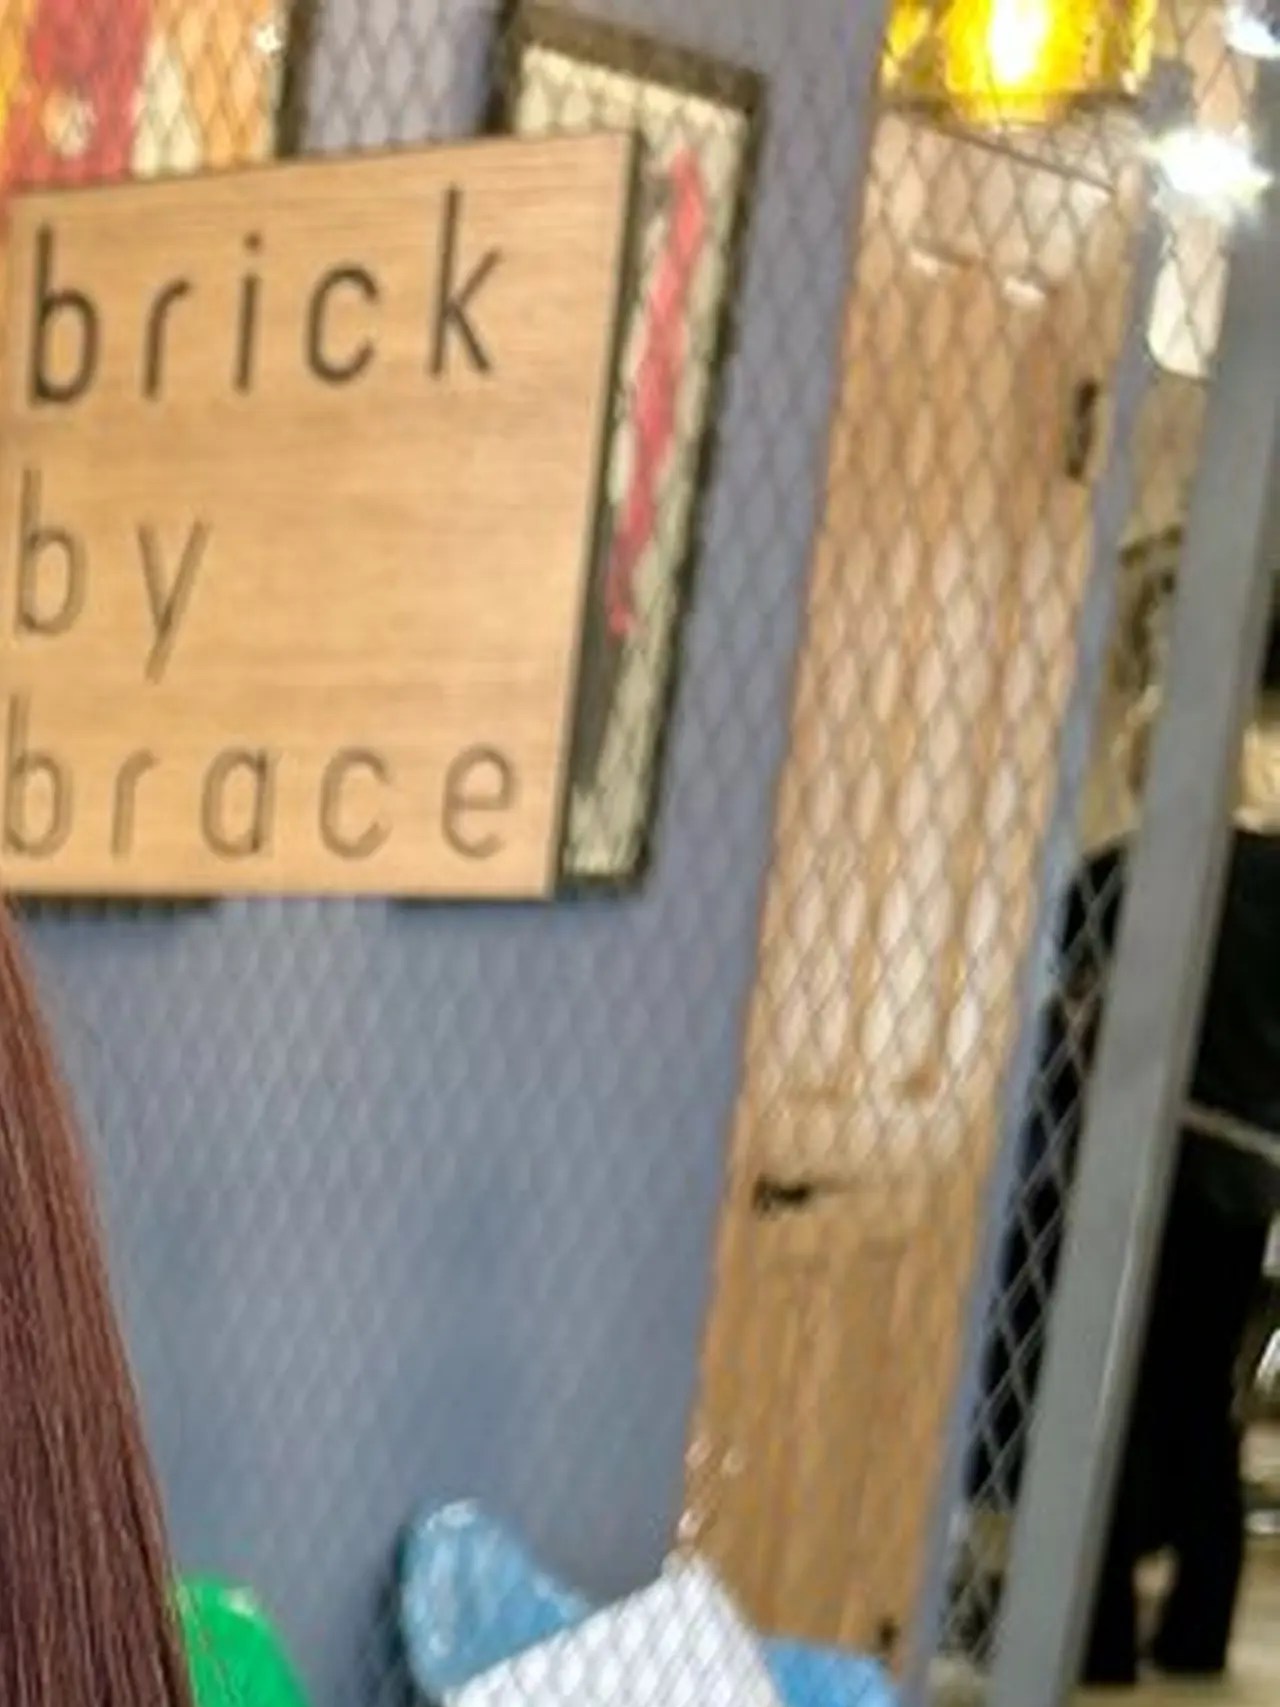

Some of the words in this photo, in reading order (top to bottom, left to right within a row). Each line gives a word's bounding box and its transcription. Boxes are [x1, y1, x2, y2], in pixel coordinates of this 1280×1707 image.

[32, 186, 503, 402] brick
[12, 468, 210, 682] by
[0, 695, 516, 858] brace
